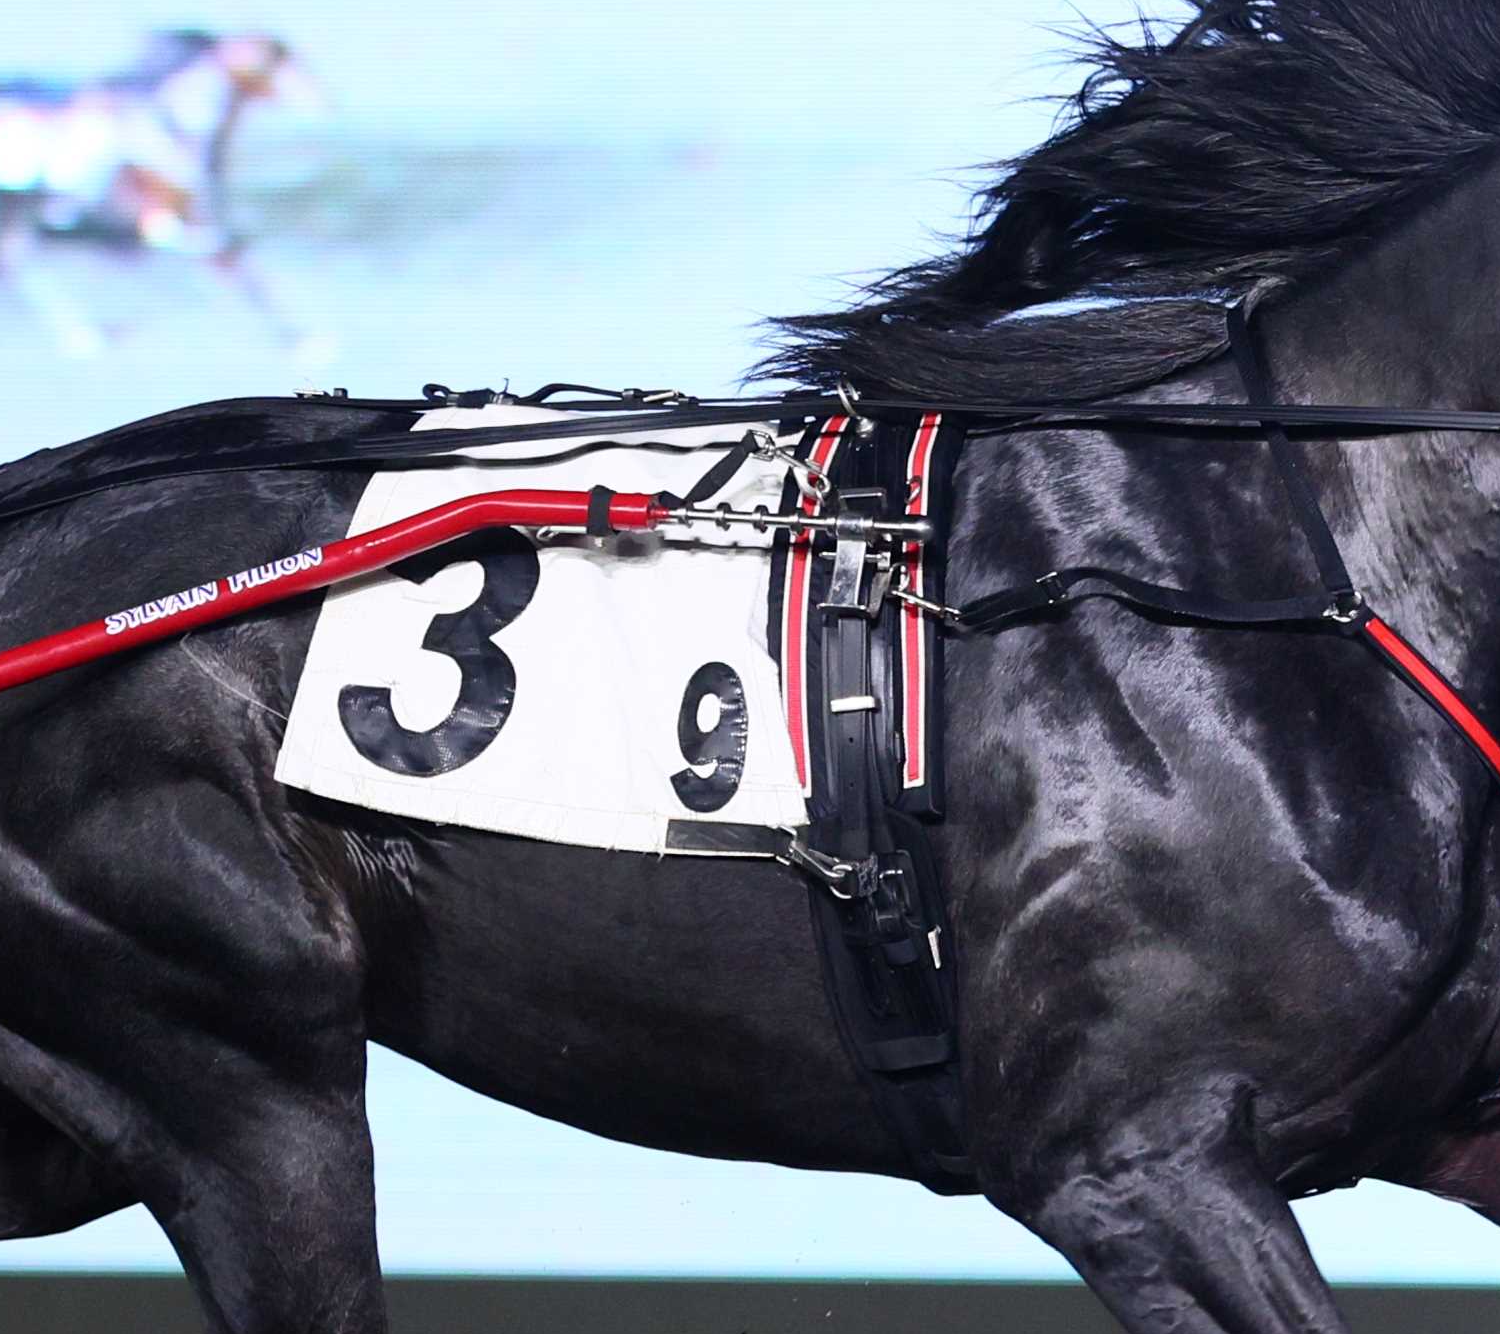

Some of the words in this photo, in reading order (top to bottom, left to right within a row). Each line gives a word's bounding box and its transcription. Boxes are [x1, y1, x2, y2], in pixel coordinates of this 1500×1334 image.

[104, 581, 220, 636] SYLVAIN
[227, 546, 323, 595] FILION
[337, 526, 541, 777] 3
[669, 661, 749, 814] 9
